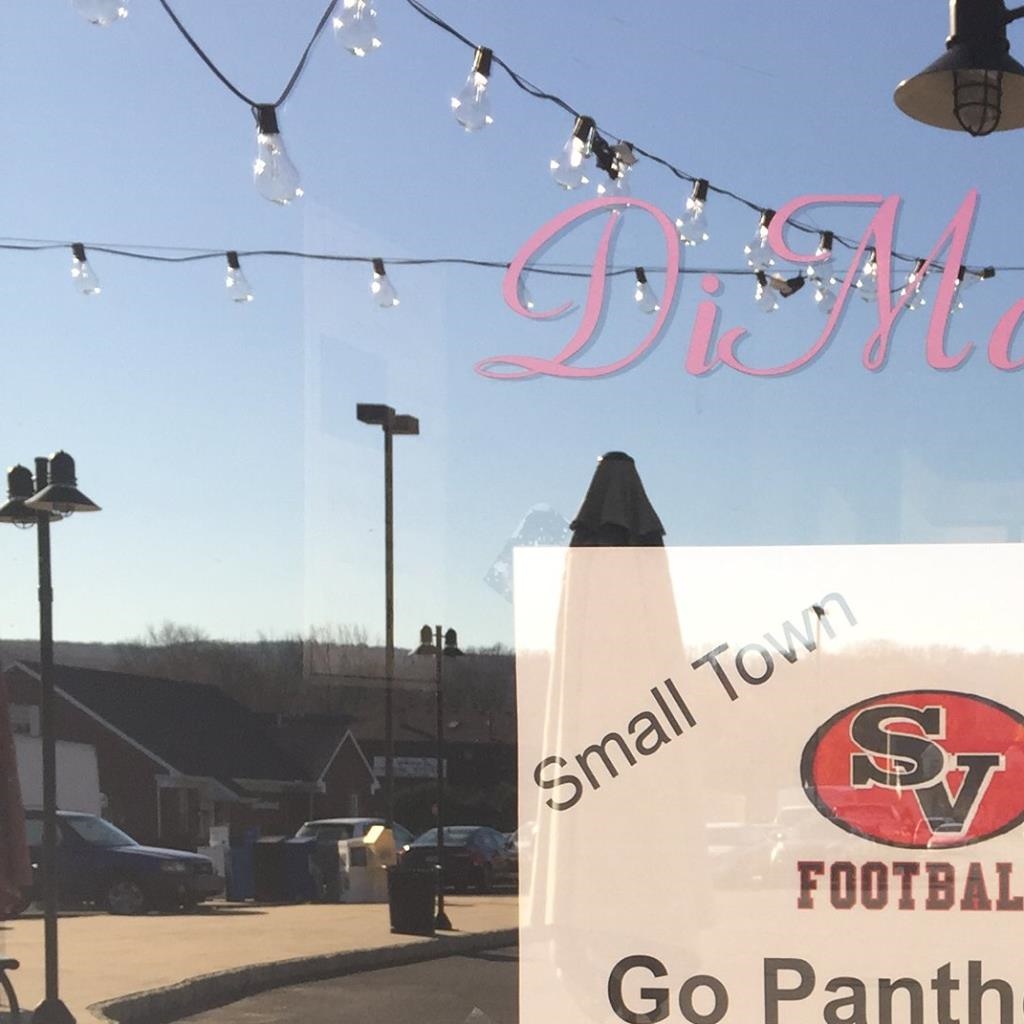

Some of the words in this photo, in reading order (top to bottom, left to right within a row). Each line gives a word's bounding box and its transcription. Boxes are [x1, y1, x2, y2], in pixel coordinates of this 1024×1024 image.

[533, 678, 697, 811] Small
[691, 590, 857, 701] Town
[850, 703, 1006, 836] SV
